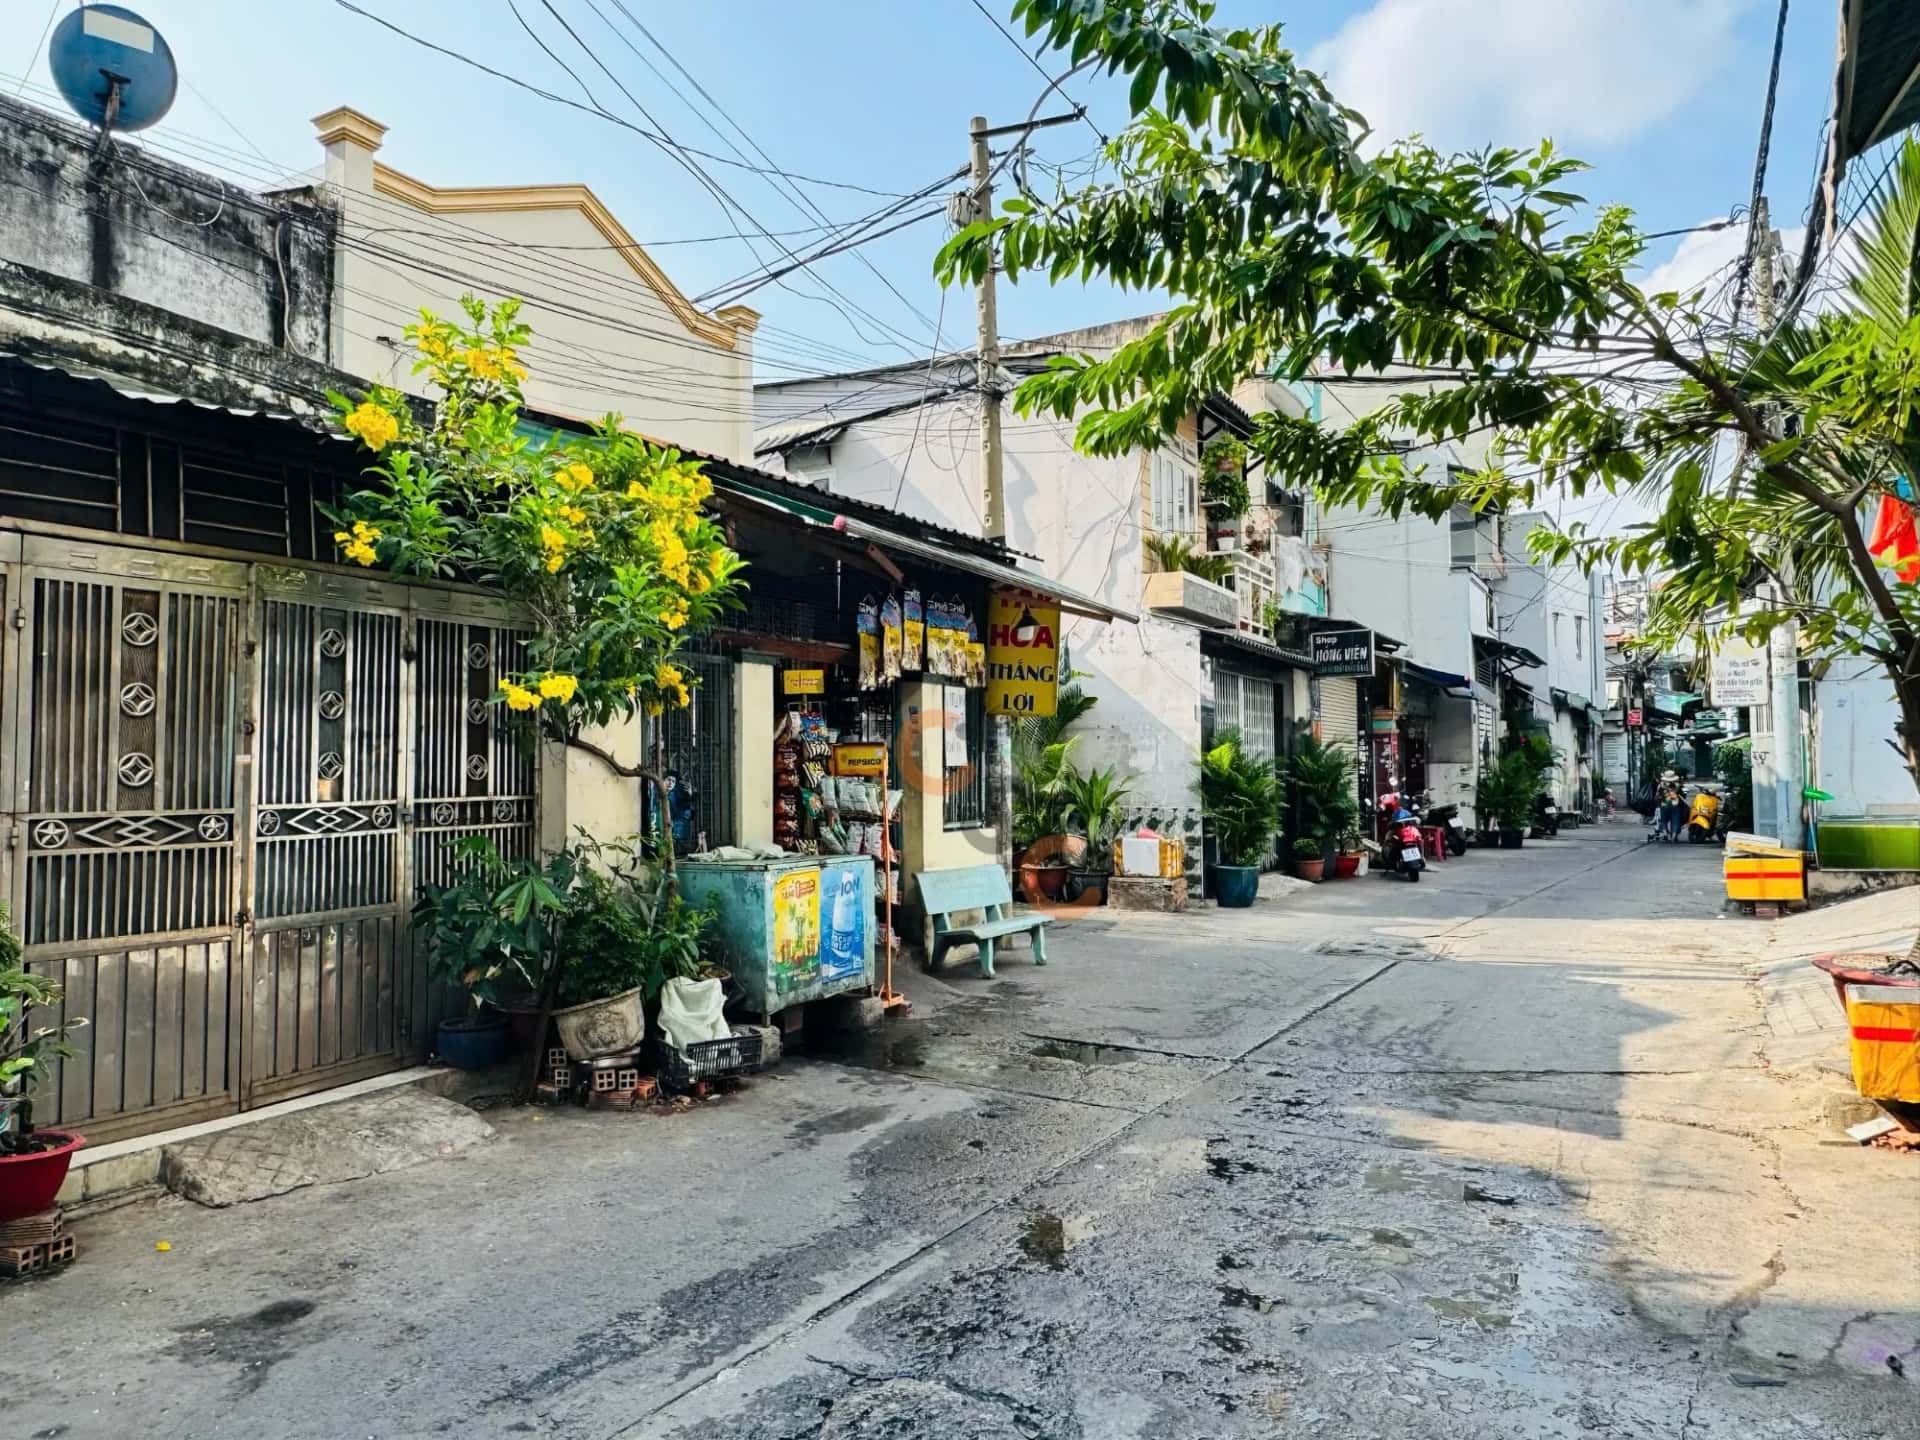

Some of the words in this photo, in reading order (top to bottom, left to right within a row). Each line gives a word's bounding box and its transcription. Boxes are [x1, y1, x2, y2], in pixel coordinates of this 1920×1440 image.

[1315, 636, 1338, 645] Shop
[989, 658, 1054, 683] THẮNG
[1002, 691, 1035, 714] LỢI
